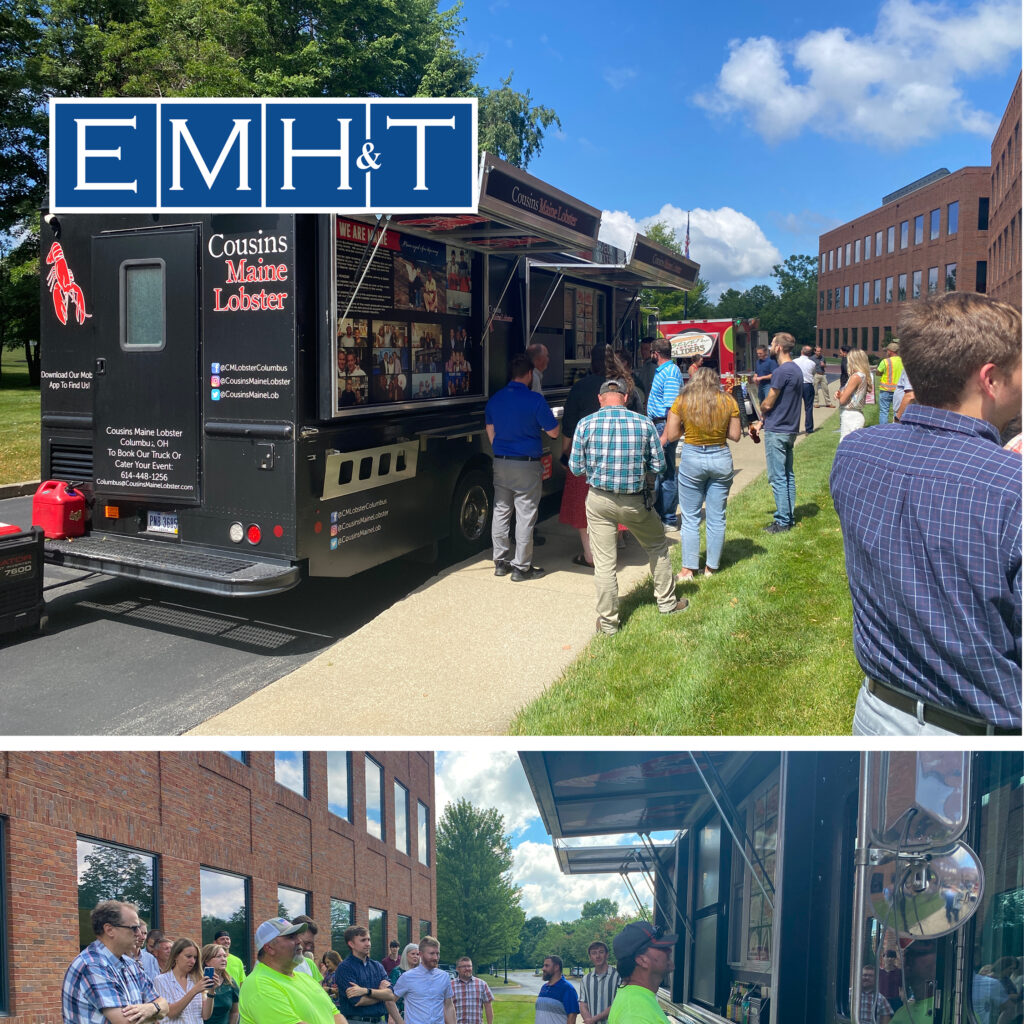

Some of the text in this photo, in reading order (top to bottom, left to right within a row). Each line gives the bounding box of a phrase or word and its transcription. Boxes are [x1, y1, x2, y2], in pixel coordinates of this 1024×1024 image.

[512, 186, 539, 211] Cousins
[339, 221, 366, 241] WE ARE
[208, 229, 288, 258] Cousins
[225, 257, 288, 283] Maine
[213, 286, 288, 311] Lobster
[219, 363, 288, 372] @CMLobsterColumbus
[41, 370, 79, 379] Download Our
[49, 381, 90, 390] App To Find Us!
[219, 377, 291, 386] @CousinsMaineLobster
[219, 390, 280, 399] @CousinsMaineLob
[106, 426, 182, 438] Cousins Maine Lobster
[157, 440, 169, 448] OH
[107, 448, 182, 460] To Book Our Truck Or
[114, 460, 173, 471] Cater Your Event:
[120, 471, 168, 481] 614-448-1256
[96, 478, 193, 491] Columbus@CousinsMaineLobster.com
